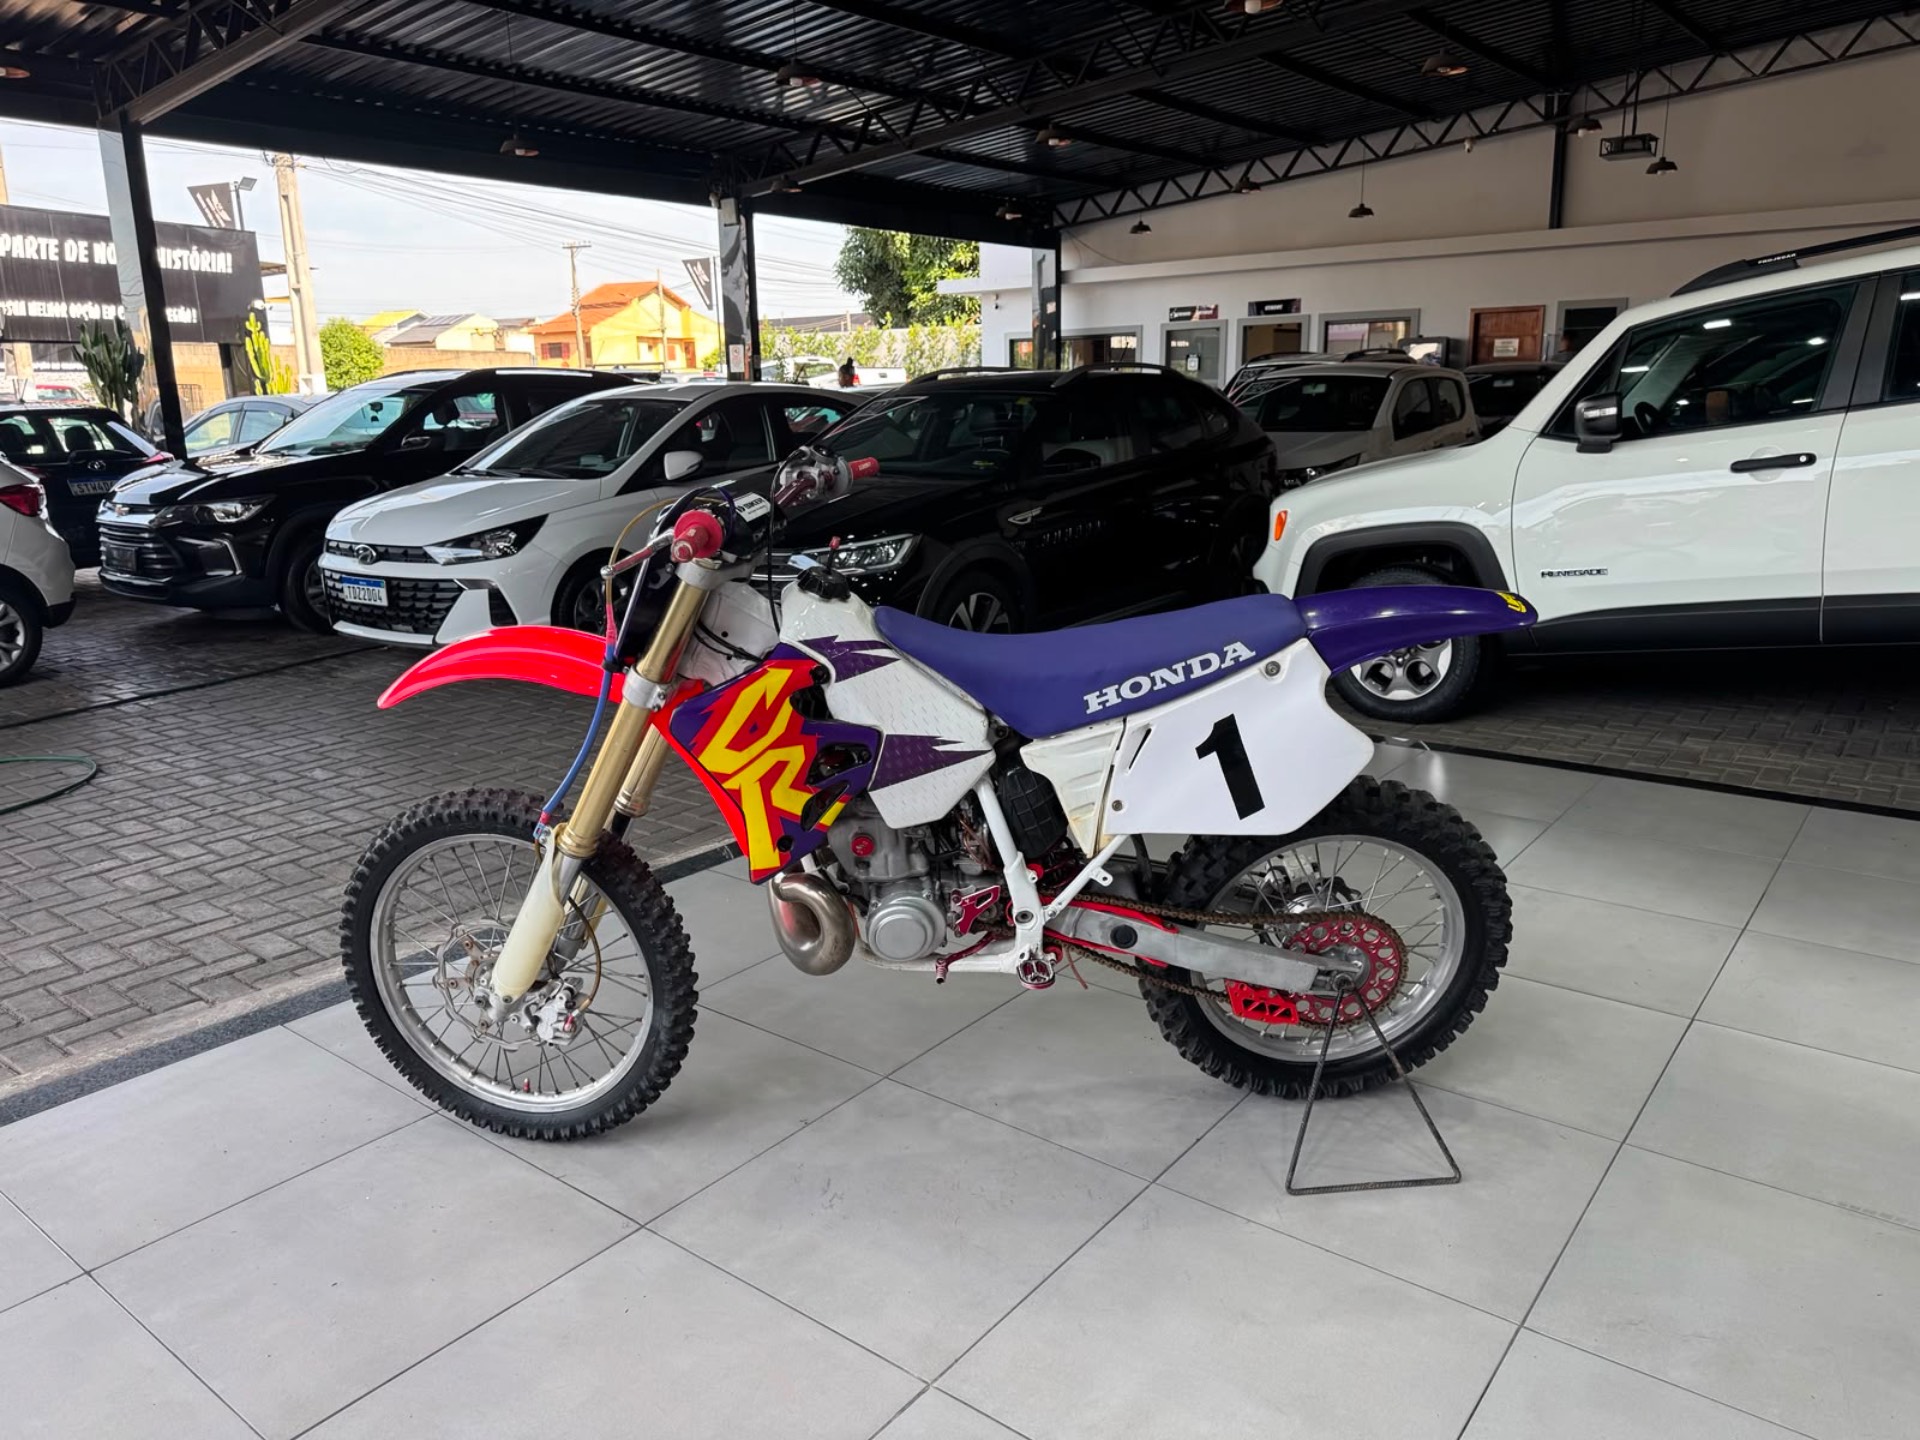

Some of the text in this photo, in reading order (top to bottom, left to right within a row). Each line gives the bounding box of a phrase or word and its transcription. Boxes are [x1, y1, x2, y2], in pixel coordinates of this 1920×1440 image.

[0, 233, 59, 261] PARTE
[64, 239, 89, 263] DE
[1541, 568, 1608, 578] RENEGADE
[1083, 641, 1256, 714] HONDA
[698, 667, 846, 870] CR
[1195, 713, 1265, 820] 1
